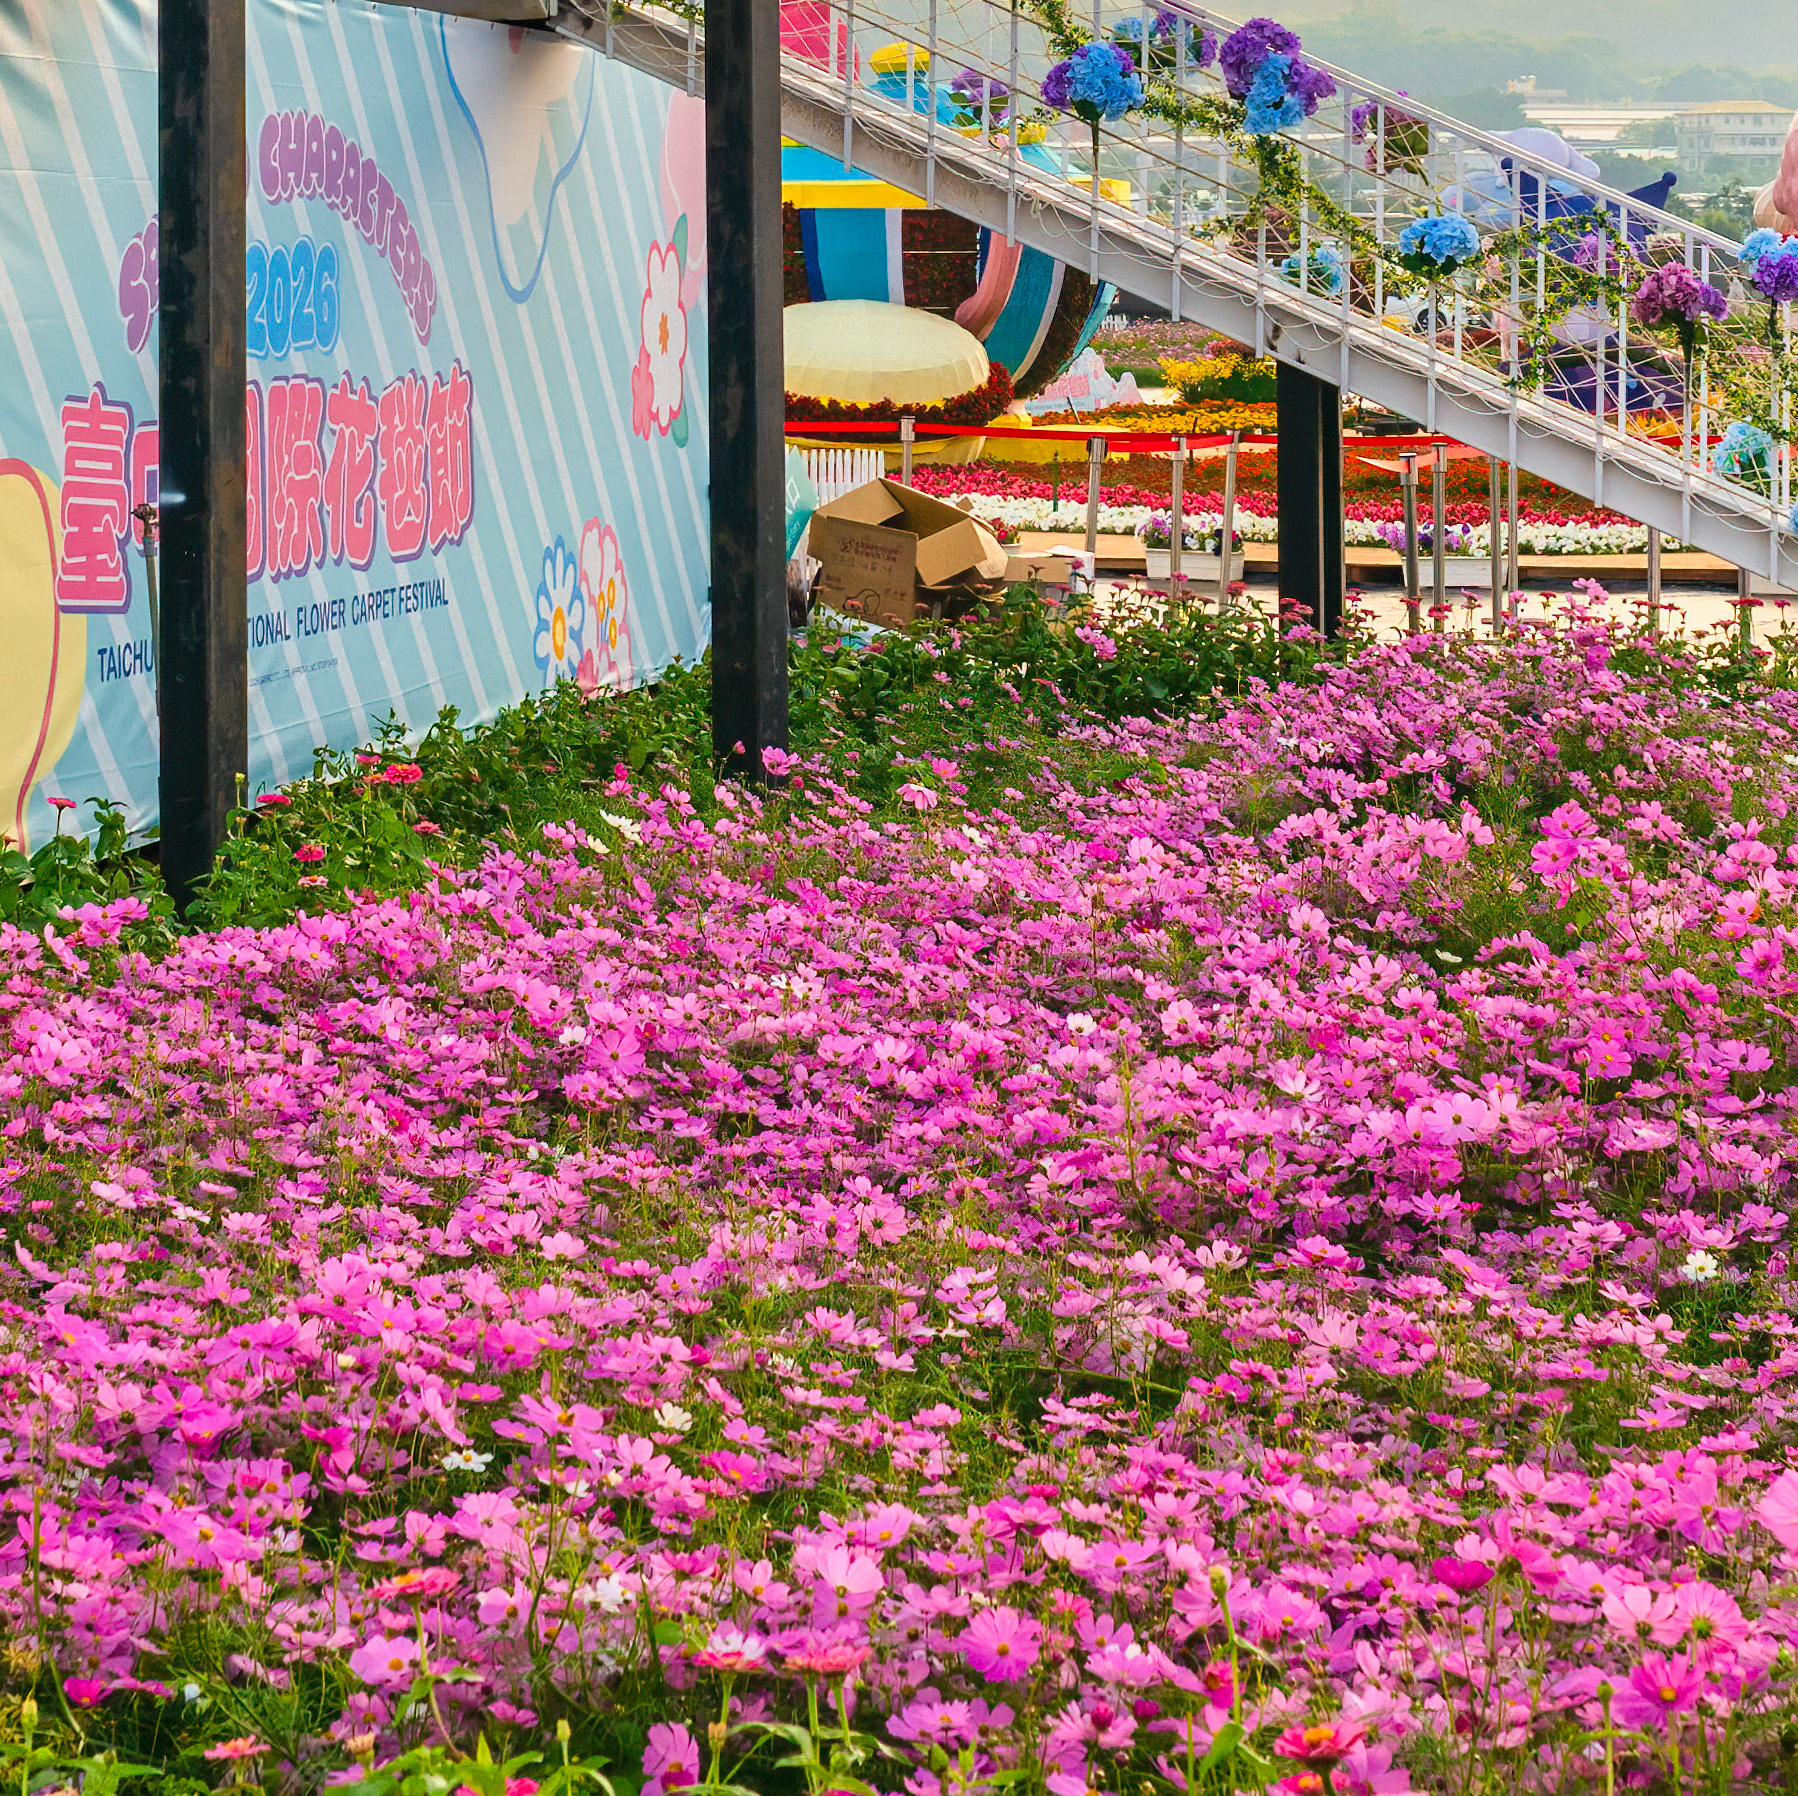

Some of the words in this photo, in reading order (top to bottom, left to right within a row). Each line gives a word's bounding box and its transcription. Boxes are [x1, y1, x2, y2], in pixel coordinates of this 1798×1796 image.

[246, 236, 341, 358] 2026
[259, 107, 436, 347] CHARACTERS
[56, 357, 474, 616] 臺際花毯節
[97, 638, 154, 683] TAICHU
[297, 598, 346, 639] FLOWER
[352, 587, 396, 626] CARPET
[398, 578, 449, 615] FESTIVAL
